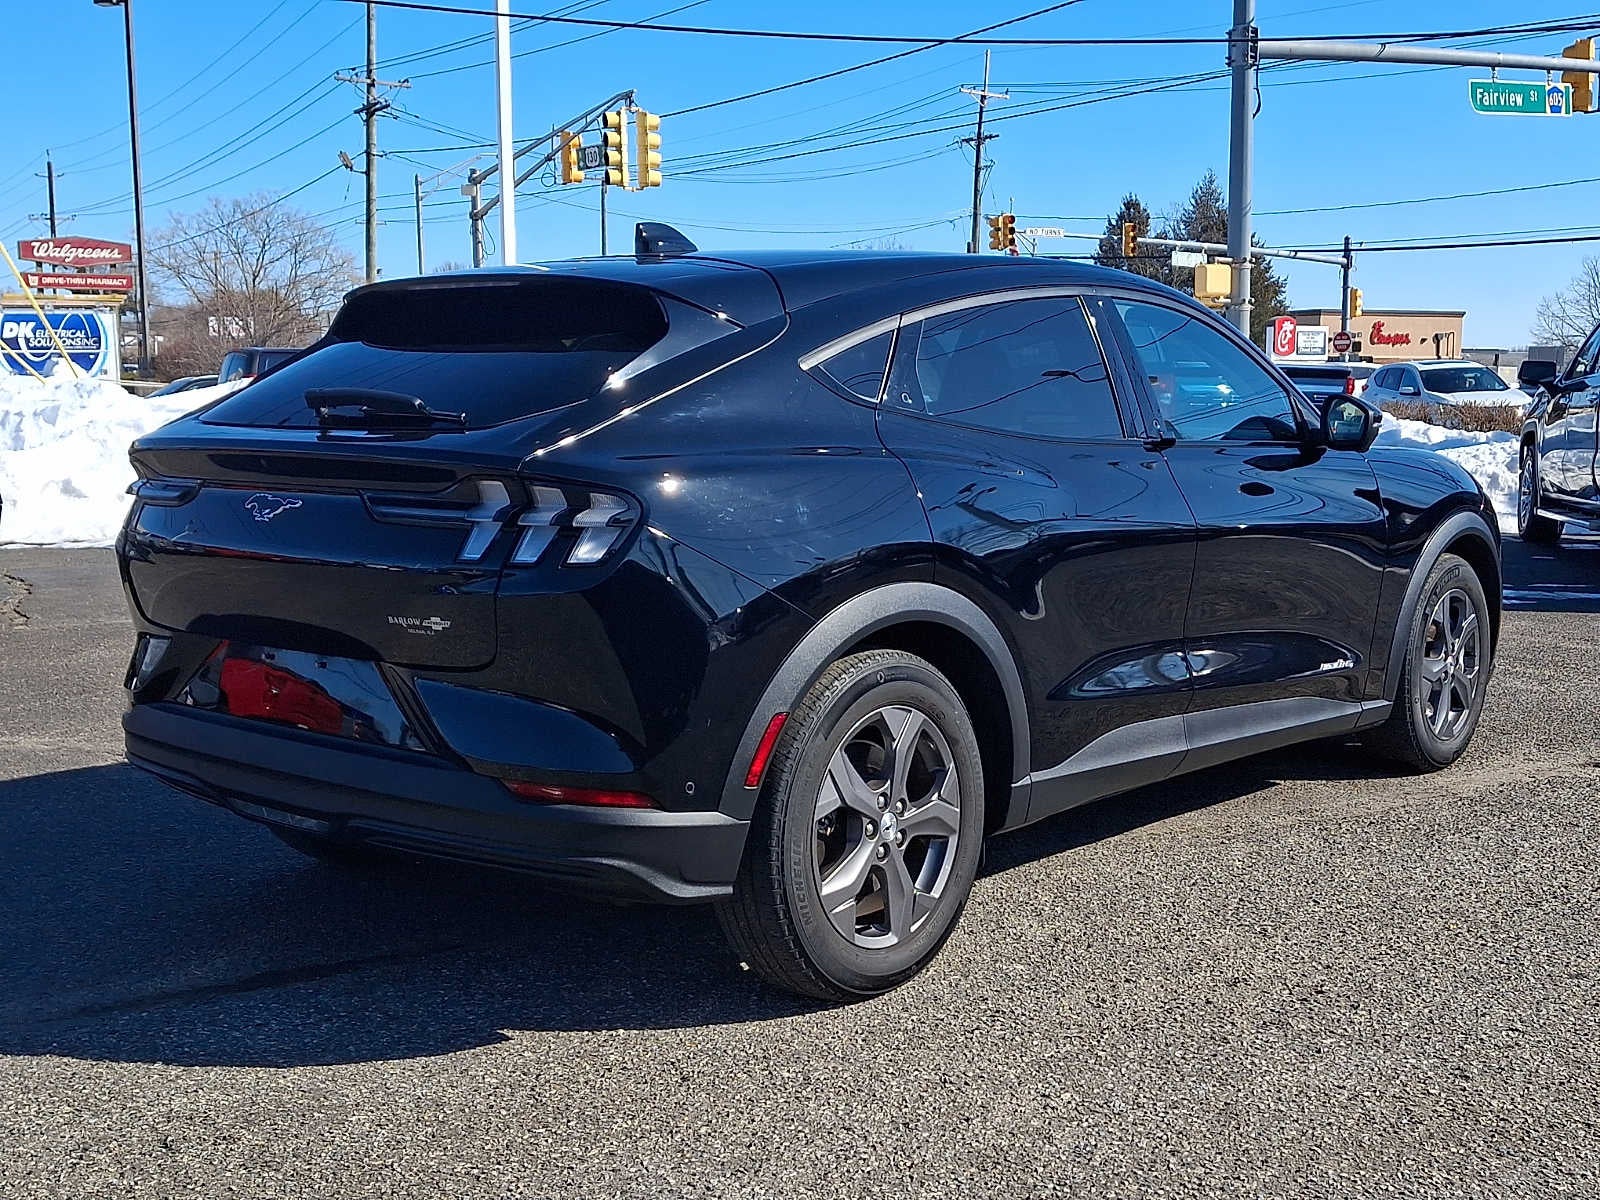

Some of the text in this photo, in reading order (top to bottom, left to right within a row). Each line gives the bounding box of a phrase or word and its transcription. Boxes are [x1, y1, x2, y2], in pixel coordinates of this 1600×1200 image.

[1476, 88, 1538, 107] Fairview St
[1549, 93, 1563, 106] 605
[587, 148, 599, 164] 130
[1029, 228, 1039, 236] NO
[31, 241, 122, 263] Walgreens
[41, 276, 127, 286] DRIVE-THRU PHARMACY
[2, 321, 36, 339] DK
[35, 329, 87, 338] ELETRICAL
[28, 337, 80, 347] SOLUONS
[387, 616, 421, 627] BARLOW
